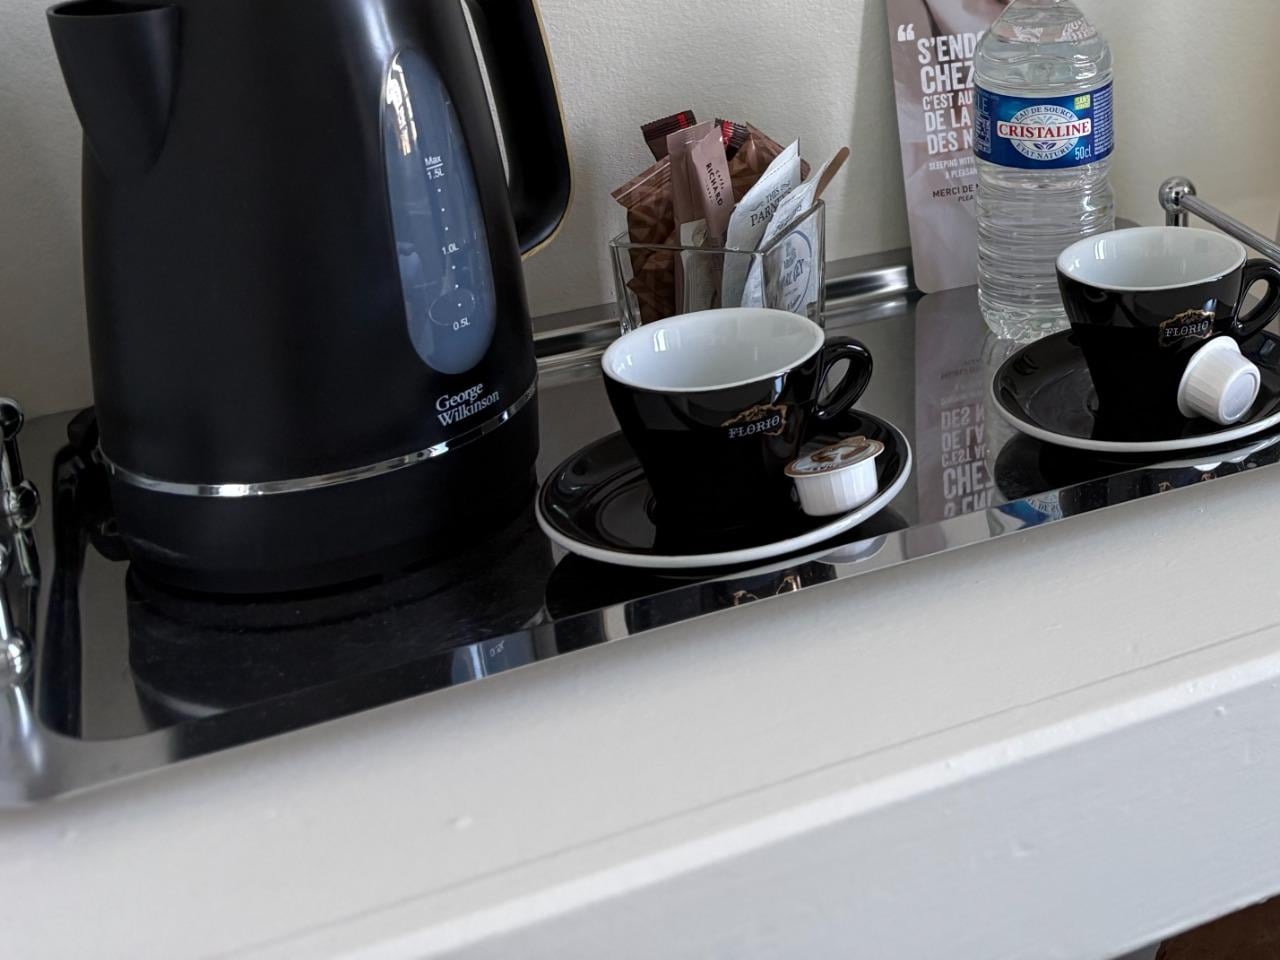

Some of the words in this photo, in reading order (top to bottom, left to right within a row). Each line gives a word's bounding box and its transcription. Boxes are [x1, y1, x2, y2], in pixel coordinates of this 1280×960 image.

[917, 30, 985, 64] S'END
[922, 93, 954, 111] C'EST
[925, 110, 946, 132] DE
[950, 106, 972, 128] LA
[1015, 108, 1030, 122] EAU
[1031, 106, 1042, 114] DE
[1044, 106, 1074, 121] SOURCE
[999, 121, 1089, 138] CRISTALINE
[927, 131, 959, 156] DES
[1075, 144, 1091, 160] 50cl
[424, 155, 441, 167] Max
[427, 168, 445, 180] 1.5L
[705, 162, 723, 206] RICHARD
[932, 187, 962, 198] MERCI
[963, 183, 974, 193] DE
[441, 242, 460, 255] 1.0L
[453, 317, 470, 331] 0.5L
[1165, 320, 1209, 337] FLORIO
[435, 383, 483, 411] George
[437, 391, 500, 427] Wilkinson
[728, 415, 780, 439] FLORIO
